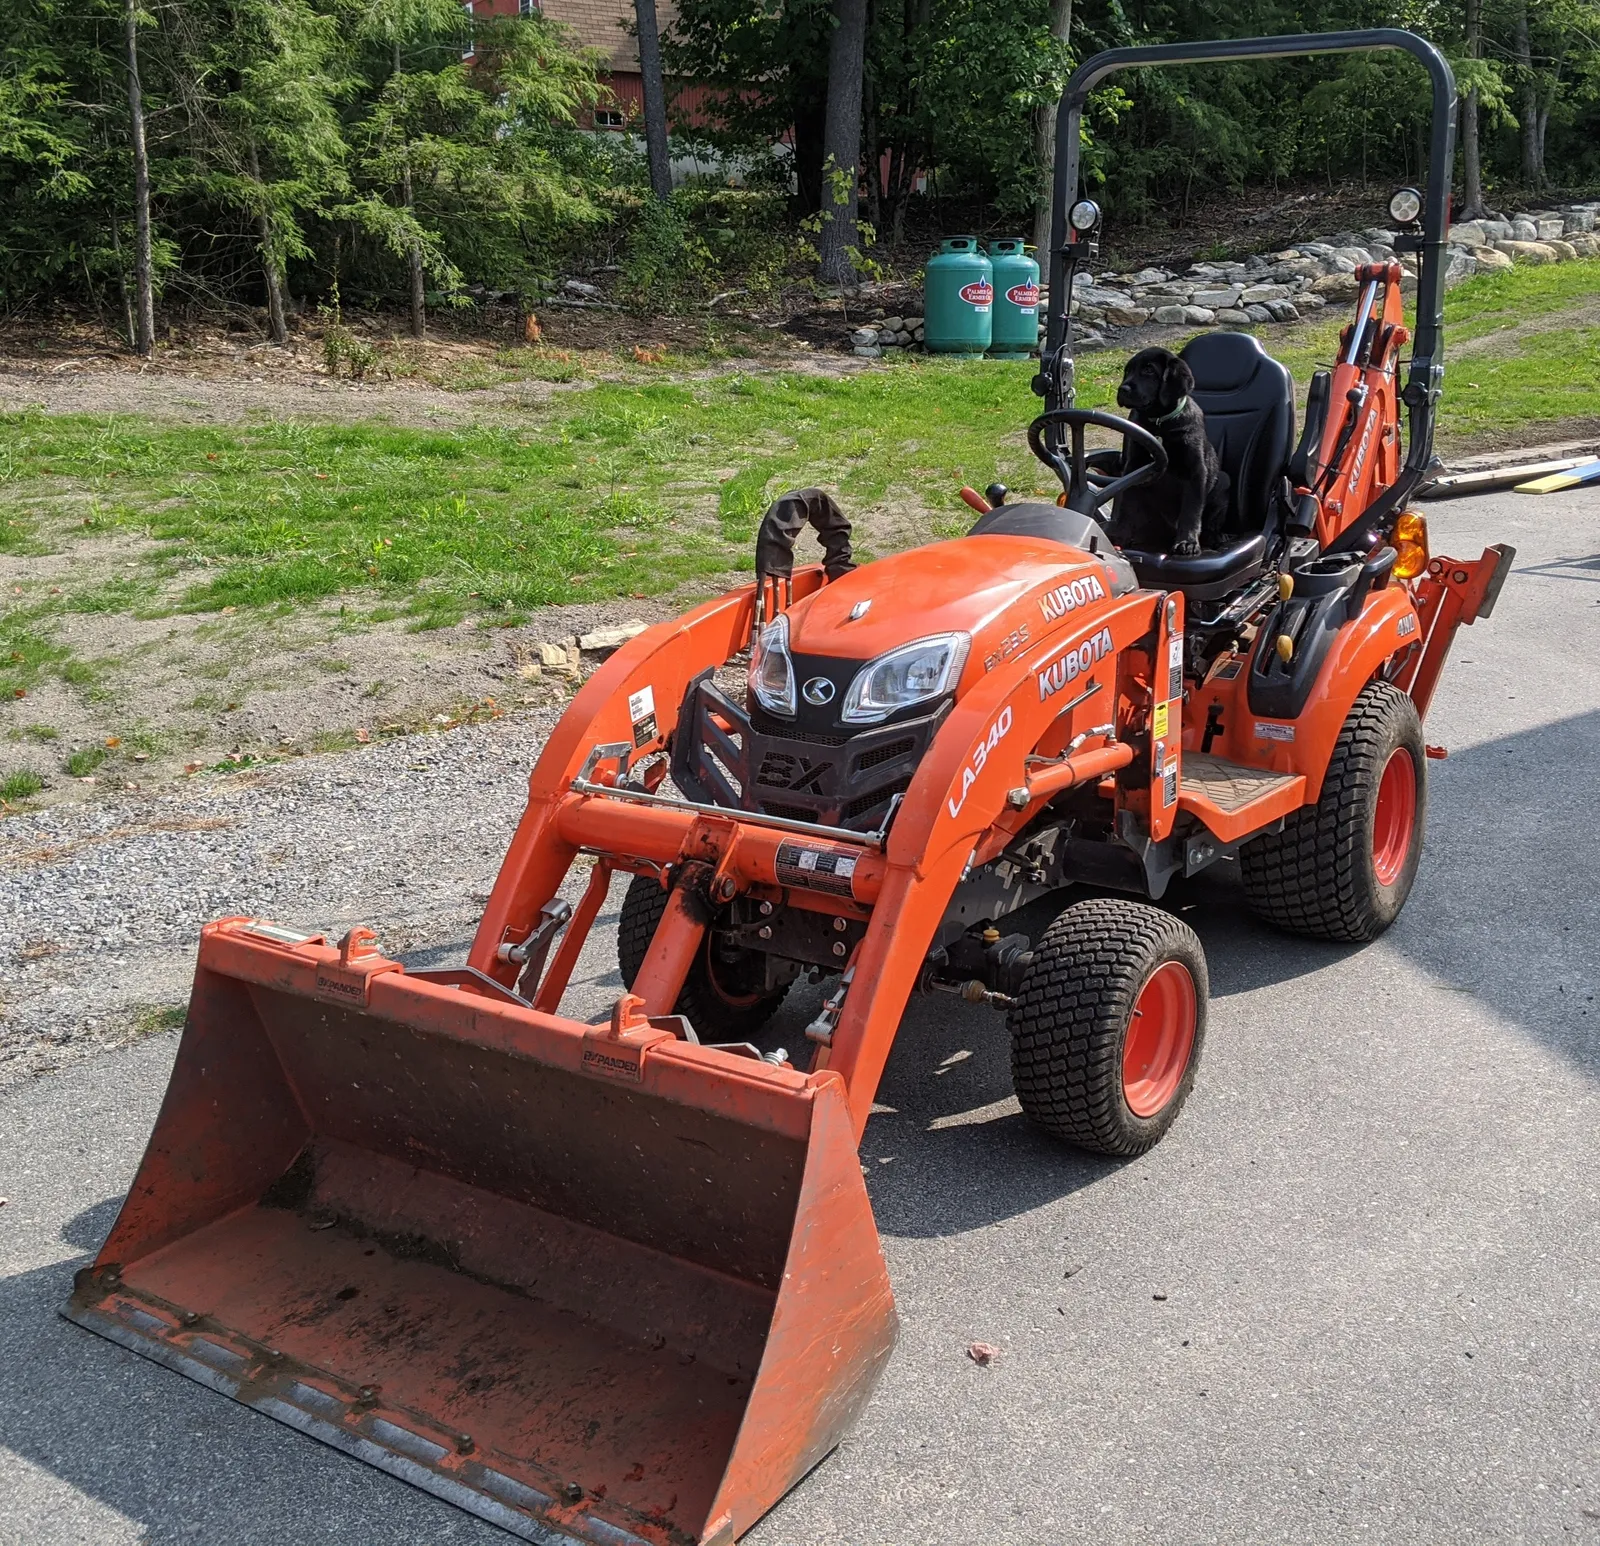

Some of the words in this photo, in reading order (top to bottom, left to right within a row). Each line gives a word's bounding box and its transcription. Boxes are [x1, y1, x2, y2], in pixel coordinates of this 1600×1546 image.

[1348, 407, 1378, 496] KUBOTA
[1037, 574, 1106, 624] KUBOTA
[1397, 611, 1415, 638] 4WD
[1038, 625, 1114, 703] KUBOTA
[756, 751, 834, 796] BX
[948, 705, 1013, 819] LA340
